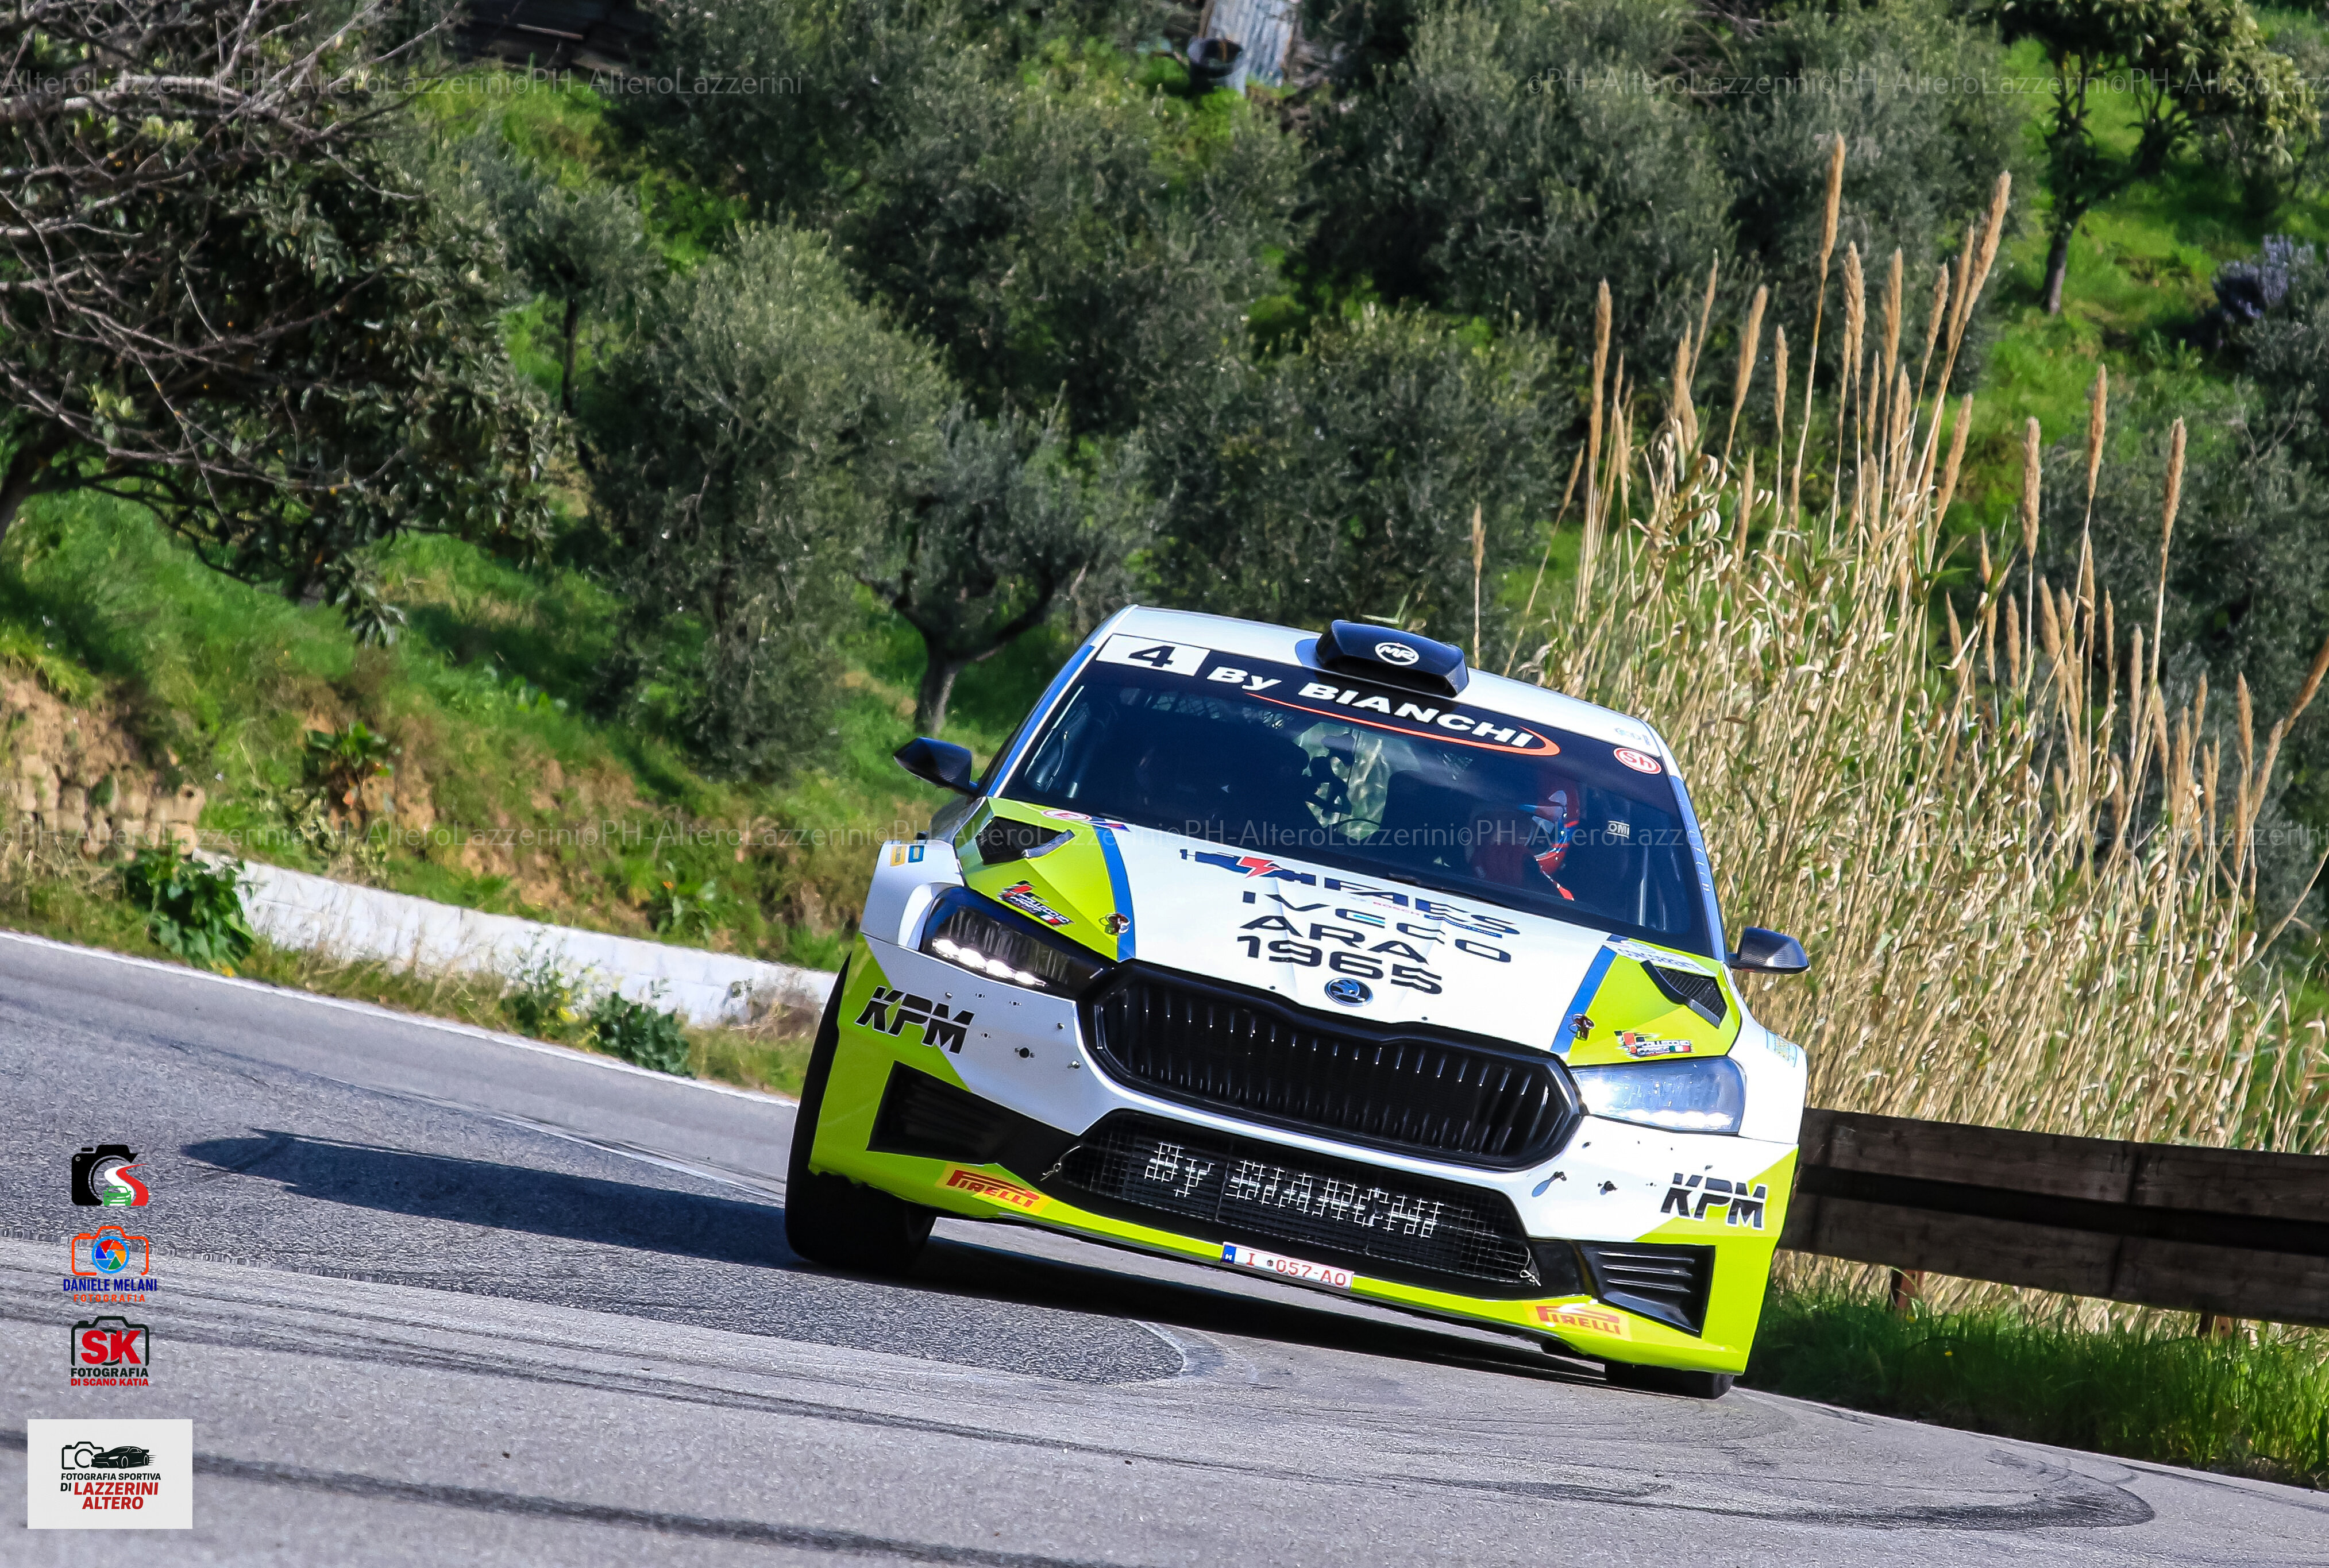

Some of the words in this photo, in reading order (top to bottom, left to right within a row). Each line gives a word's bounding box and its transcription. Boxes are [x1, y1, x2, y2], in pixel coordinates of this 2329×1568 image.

[1128, 644, 1177, 668] 4
[1297, 682, 1535, 748] BIANCHI
[1623, 751, 1653, 769] Sh
[1240, 915, 1429, 965] ARA
[1242, 890, 1511, 963] IVECO
[1237, 935, 1443, 995] 1965
[855, 986, 975, 1055] KPM
[946, 1169, 1040, 1208] PIRELLI
[1660, 1172, 1768, 1230] KPM
[1535, 1306, 1621, 1335] PIRELLI
